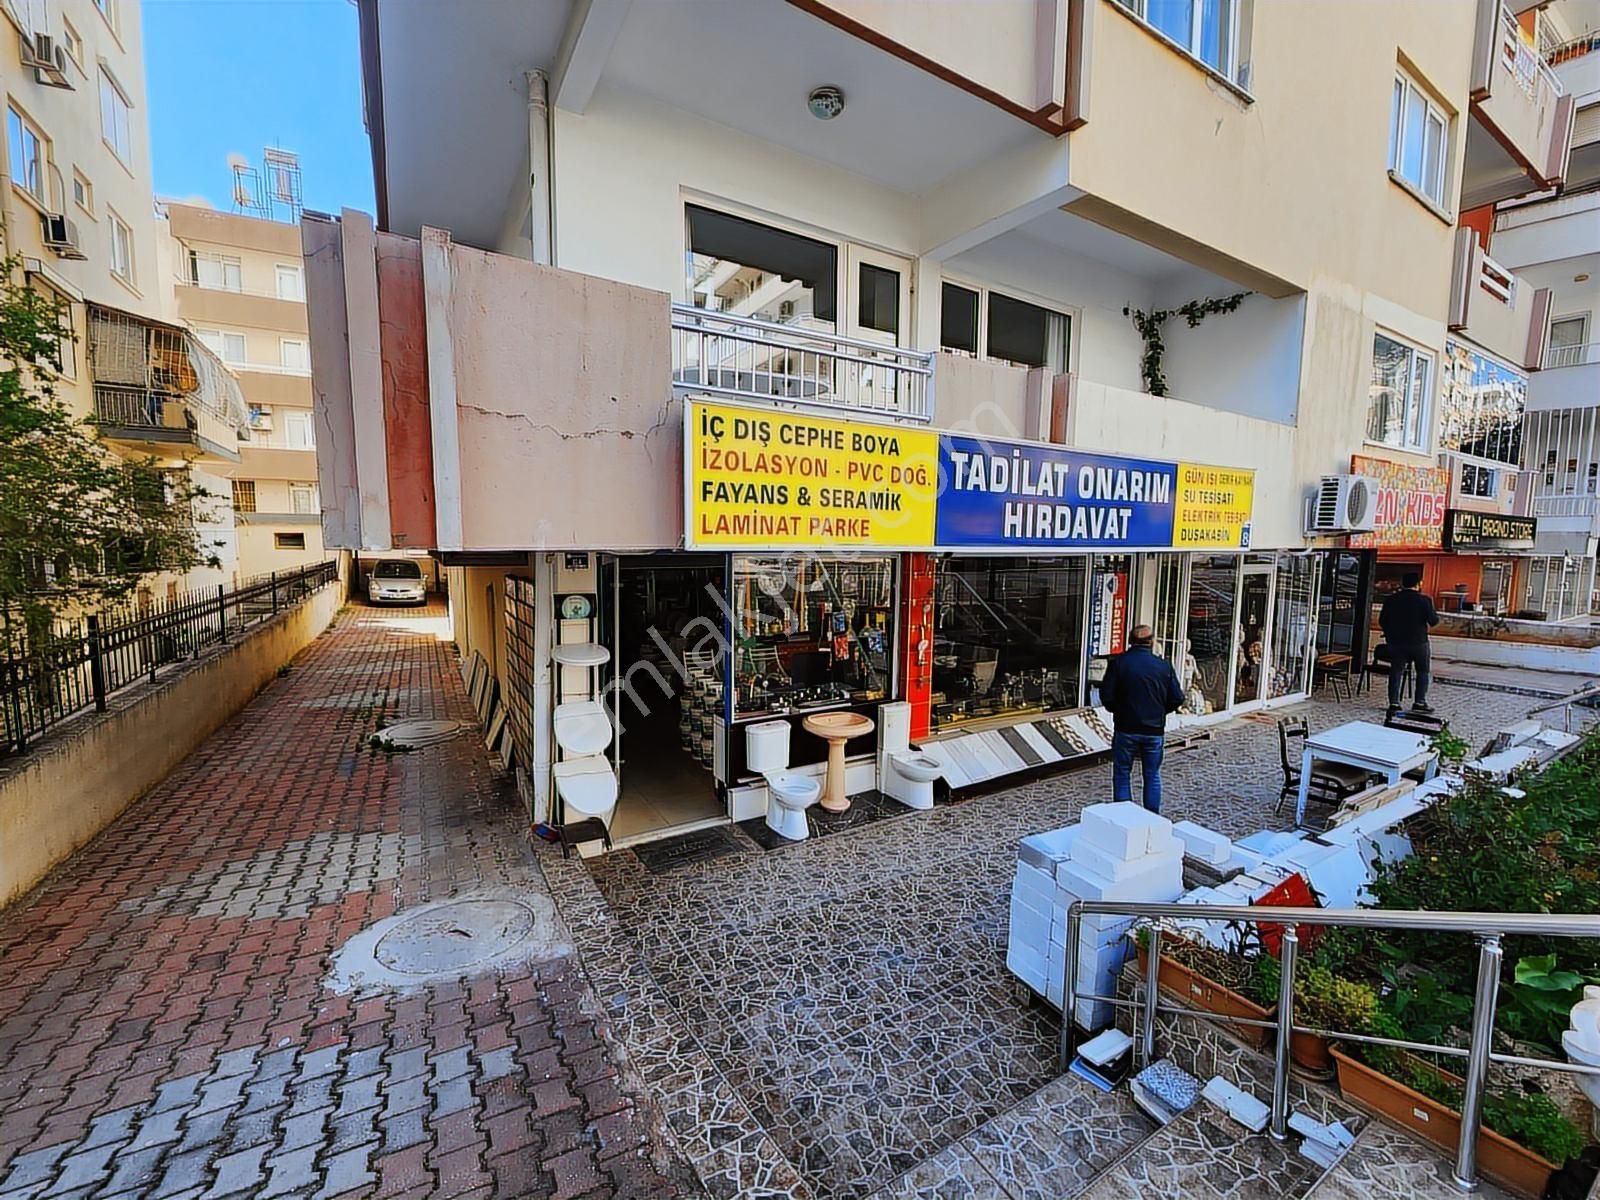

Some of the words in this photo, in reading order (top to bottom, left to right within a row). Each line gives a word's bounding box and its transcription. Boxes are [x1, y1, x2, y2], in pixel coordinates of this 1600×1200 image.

[702, 408, 725, 443] İÇ
[734, 418, 771, 448] DIŞ
[780, 424, 844, 450] CEPHE
[852, 433, 900, 457] BOYA
[702, 442, 828, 478] İZOLASYON
[848, 461, 884, 483] PVC
[950, 448, 1069, 498] TADİLAT
[1078, 466, 1171, 505] ONARIM
[702, 481, 789, 505] FAYANS
[797, 485, 811, 507] &
[820, 487, 902, 512] SERAMİK
[1184, 490, 1196, 503] SU
[1405, 490, 1445, 528] KIDS
[701, 509, 802, 537] LAMİNAT
[809, 517, 871, 538] PARKE
[1003, 502, 1132, 540] HIRDAVAT
[1481, 518, 1509, 537] BRAND
[1510, 522, 1534, 540] STORE
[1112, 598, 1123, 649] Satılık
